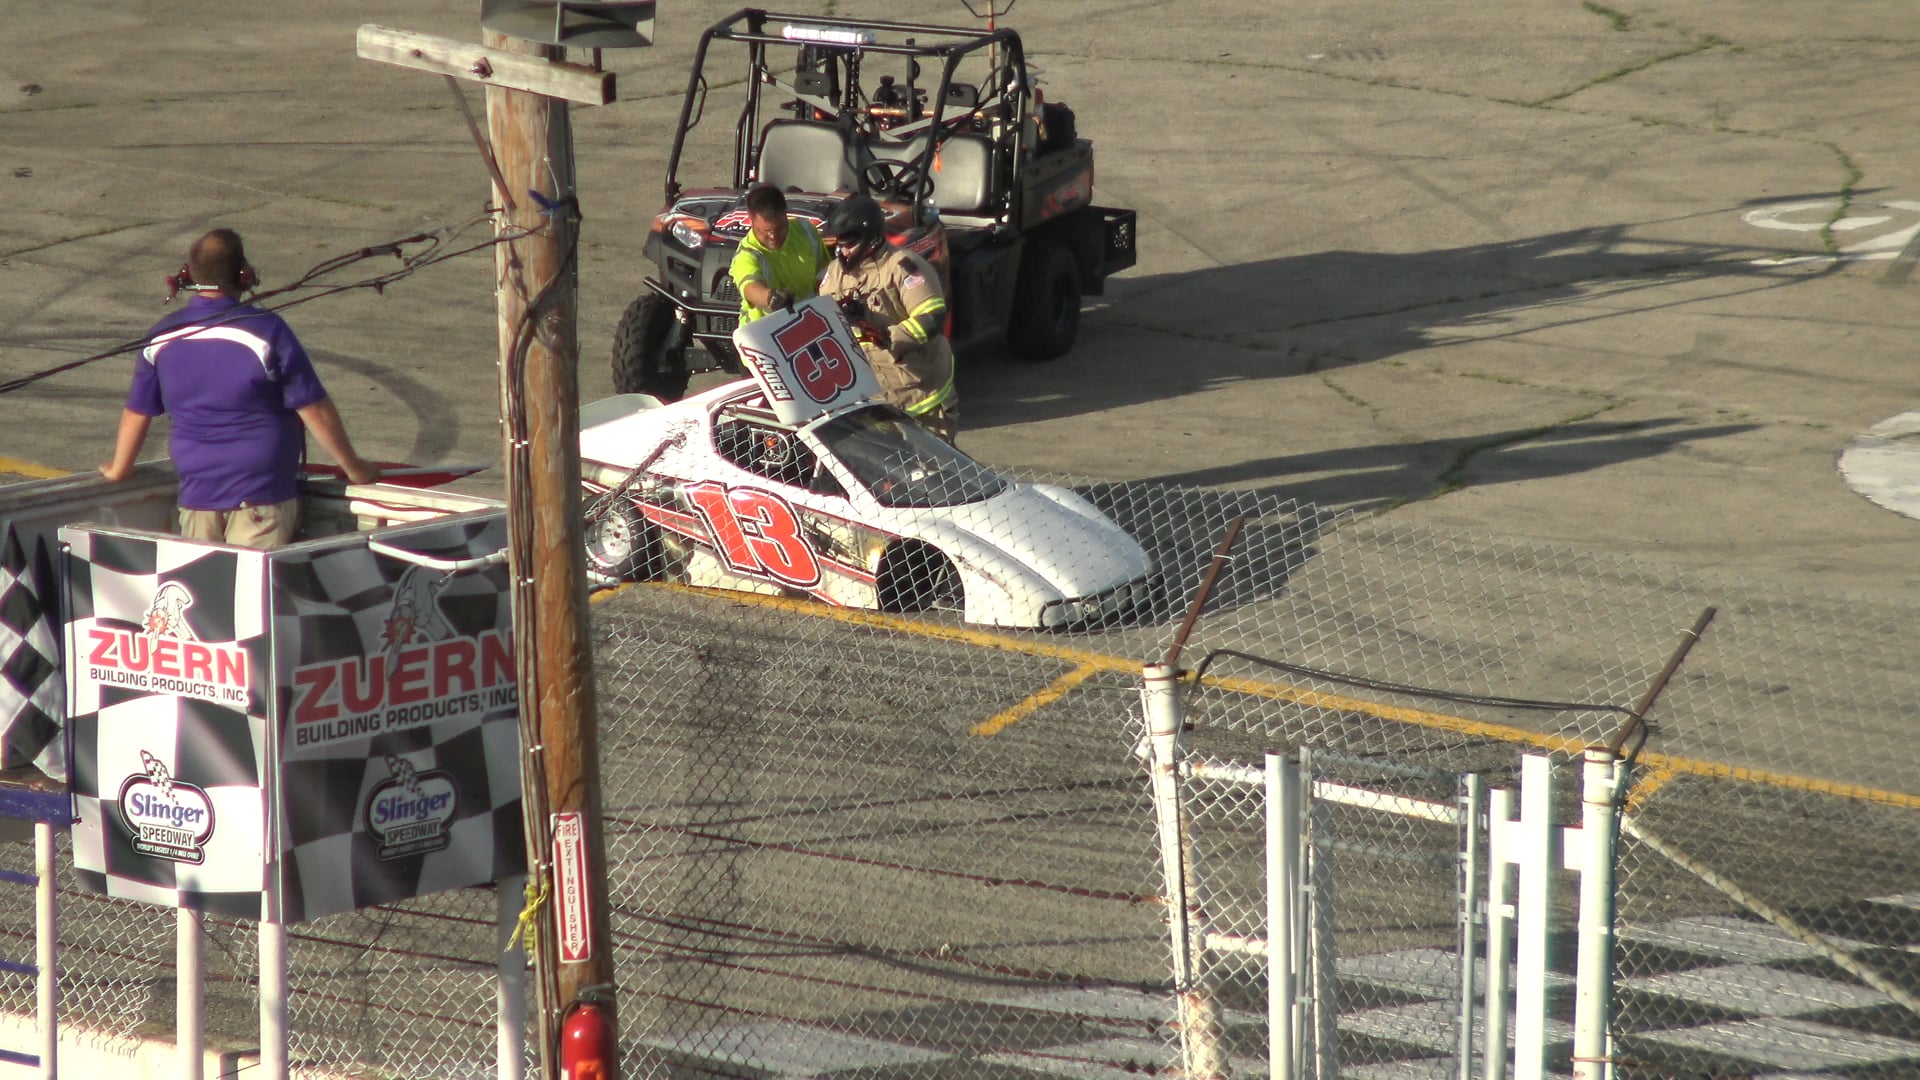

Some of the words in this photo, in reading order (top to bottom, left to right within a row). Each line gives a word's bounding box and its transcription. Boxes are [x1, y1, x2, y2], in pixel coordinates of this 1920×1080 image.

[771, 304, 857, 405] 13
[679, 479, 822, 590] 13
[89, 629, 246, 687] ZUERN
[295, 632, 515, 724] ZUERN
[90, 668, 147, 687] BUILDING
[152, 677, 219, 699] PRODUCTS,
[222, 689, 247, 703] INC.
[297, 713, 381, 746] BUILDING
[386, 695, 484, 728] PRODUCTS,
[130, 793, 204, 827] Slinger
[375, 791, 451, 824] Slinger
[142, 826, 193, 847] SPEEDWAY
[388, 821, 439, 844] SPEEDWAY
[557, 823, 577, 836] FIRE
[564, 839, 579, 950] EXTINGUISHER
